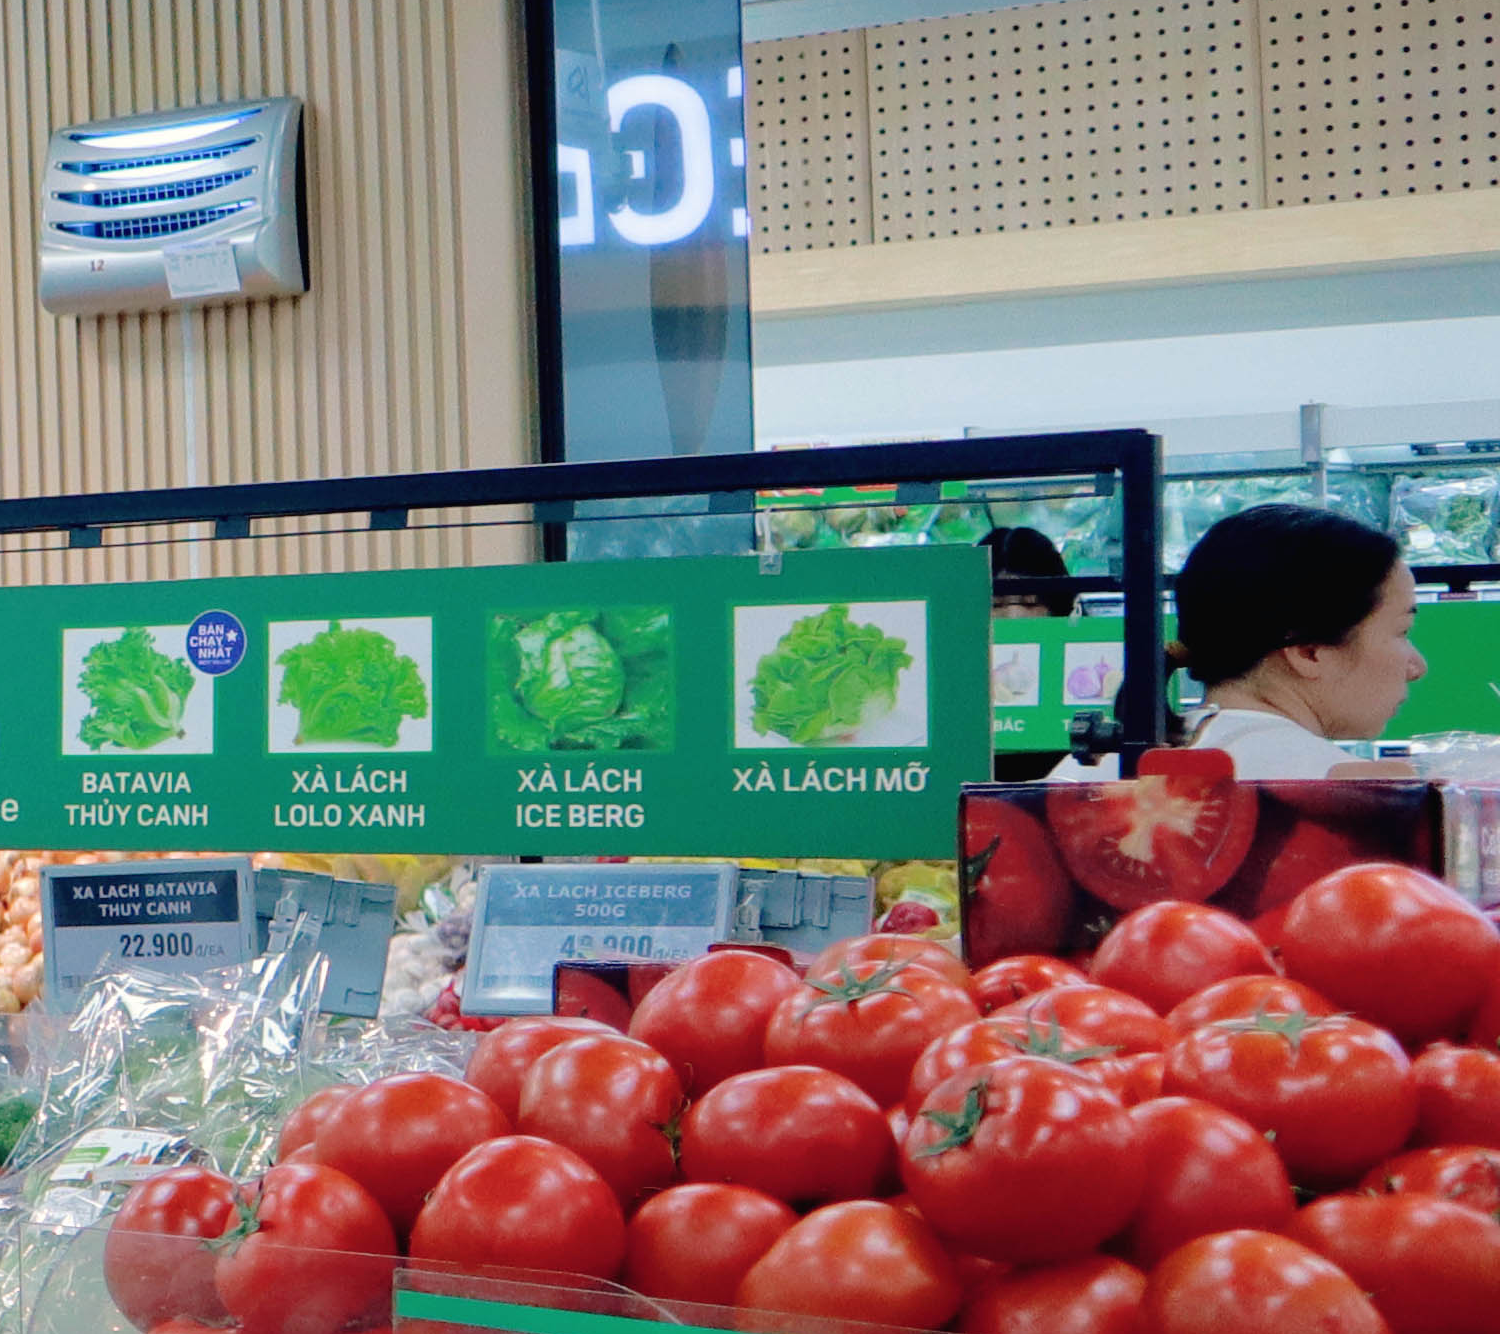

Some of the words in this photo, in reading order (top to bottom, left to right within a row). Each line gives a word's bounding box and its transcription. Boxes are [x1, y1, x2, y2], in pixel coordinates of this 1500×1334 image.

[83, 771, 192, 794] BATAVIA
[292, 766, 330, 794] XÀ
[336, 765, 407, 793] LÁCH
[517, 763, 559, 792] XÀ
[564, 762, 643, 792] LÁCH
[732, 762, 776, 792] XÀ
[783, 761, 868, 792] LÁCH
[874, 763, 930, 792] MỠ
[65, 797, 132, 827] THỦY
[137, 804, 208, 827] CANH
[274, 804, 342, 827] LOLO
[348, 804, 425, 827] XANH
[516, 804, 563, 827] ICE
[569, 804, 645, 828] BERG
[73, 886, 94, 899] XA
[100, 885, 139, 898] LACH
[145, 881, 217, 897] BATAVIA
[99, 904, 141, 916] THUY
[147, 901, 191, 915] CANH
[120, 933, 193, 957] 22.900
